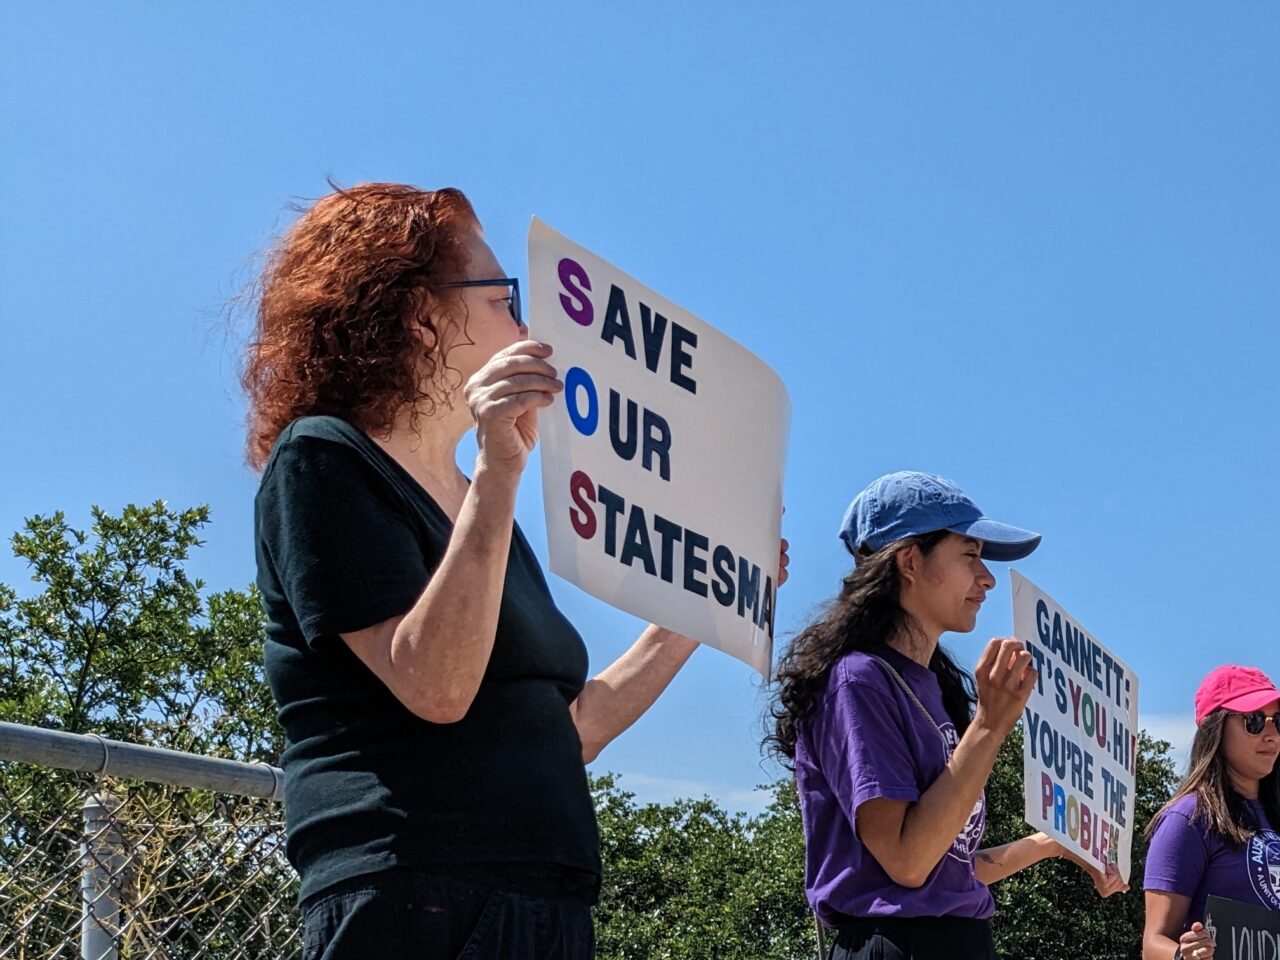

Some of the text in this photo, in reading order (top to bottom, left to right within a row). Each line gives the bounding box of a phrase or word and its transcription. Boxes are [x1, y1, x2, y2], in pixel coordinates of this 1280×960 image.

[557, 257, 698, 395] SAVE
[564, 366, 672, 482] OUR
[1036, 598, 1130, 710] GANNETT:
[1025, 706, 1127, 829] YOU'RE THE
[1067, 677, 1111, 753] YOU.
[1113, 717, 1136, 776] HI!
[1041, 771, 1119, 866] PROBLEM
